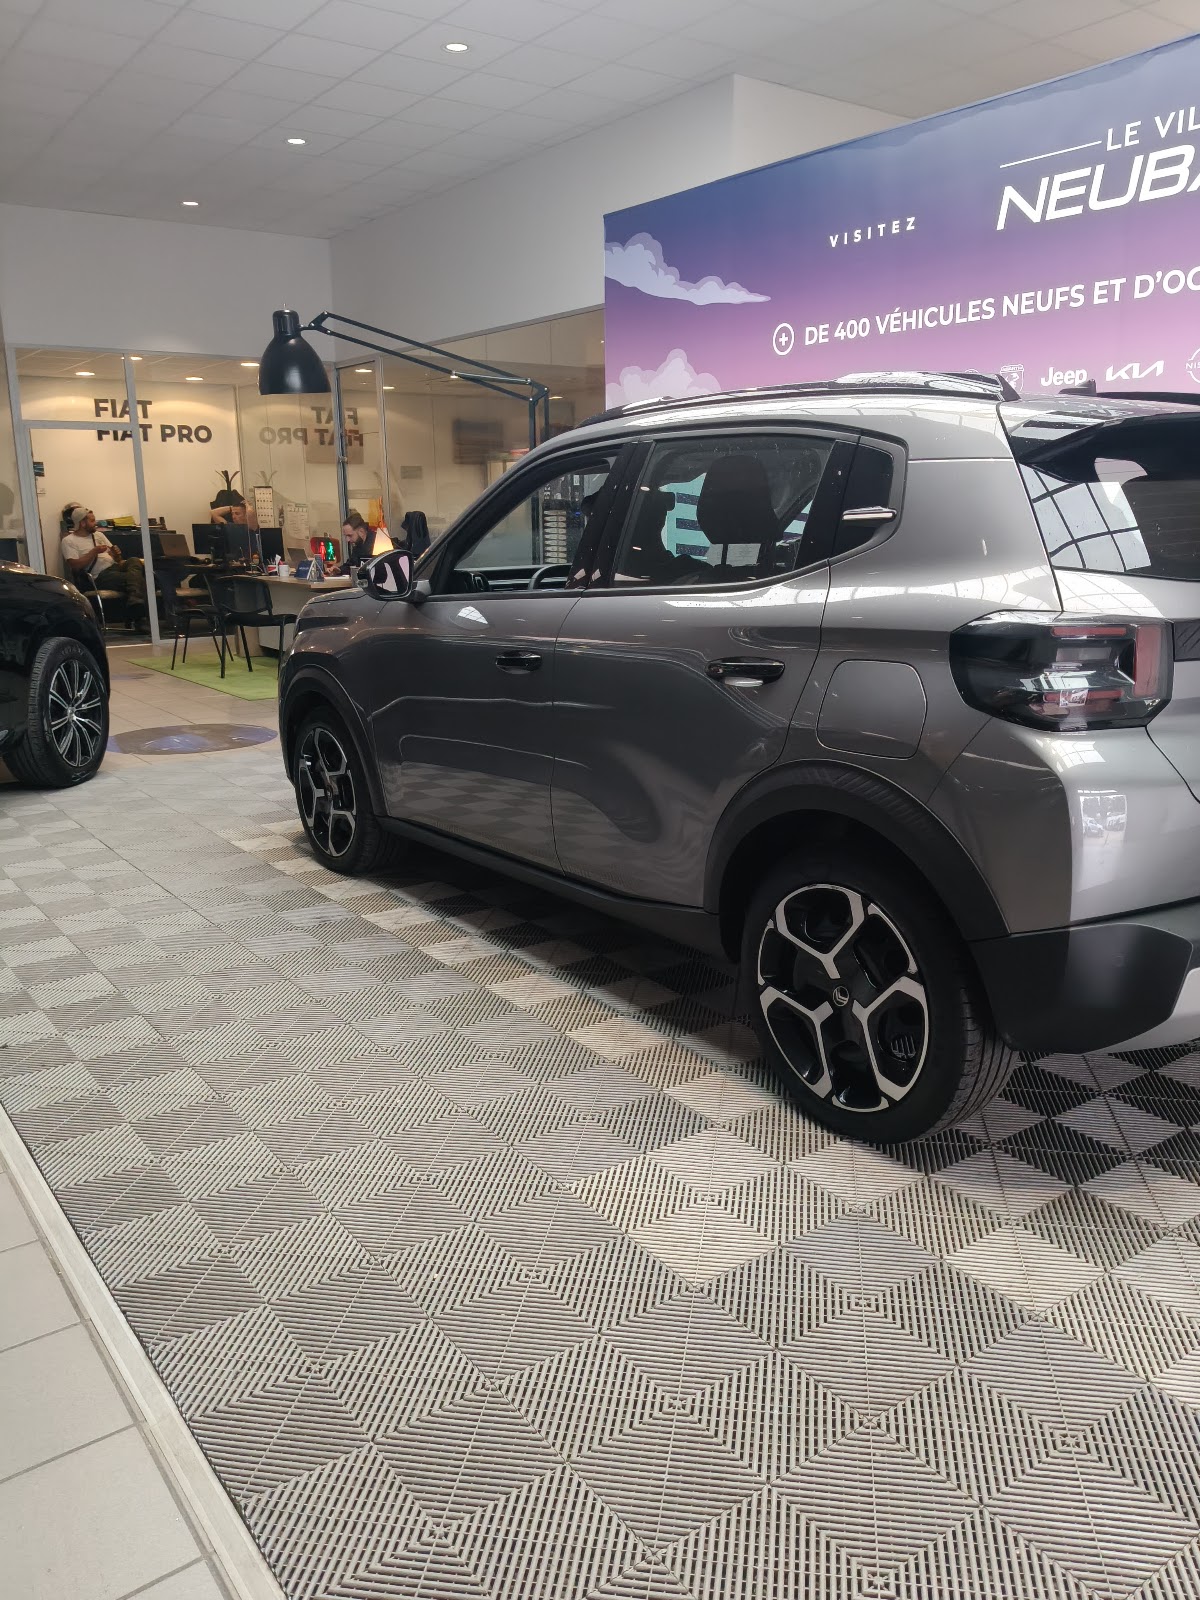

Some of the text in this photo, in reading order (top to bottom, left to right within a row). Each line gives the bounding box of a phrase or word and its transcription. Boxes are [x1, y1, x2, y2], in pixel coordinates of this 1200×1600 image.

[1106, 106, 1200, 152] LE VIL
[996, 144, 1200, 231] NEUB
[829, 216, 916, 248] VISITEZ
[804, 323, 830, 346] DE
[834, 317, 871, 341] 400
[875, 297, 996, 335] VÉHICULES
[1002, 284, 1085, 317] NEUFS
[1093, 277, 1127, 305] ET
[1040, 367, 1088, 387] Jeep
[1106, 360, 1165, 382] KIA
[94, 398, 152, 419] FIAT
[160, 424, 213, 443] PRO
